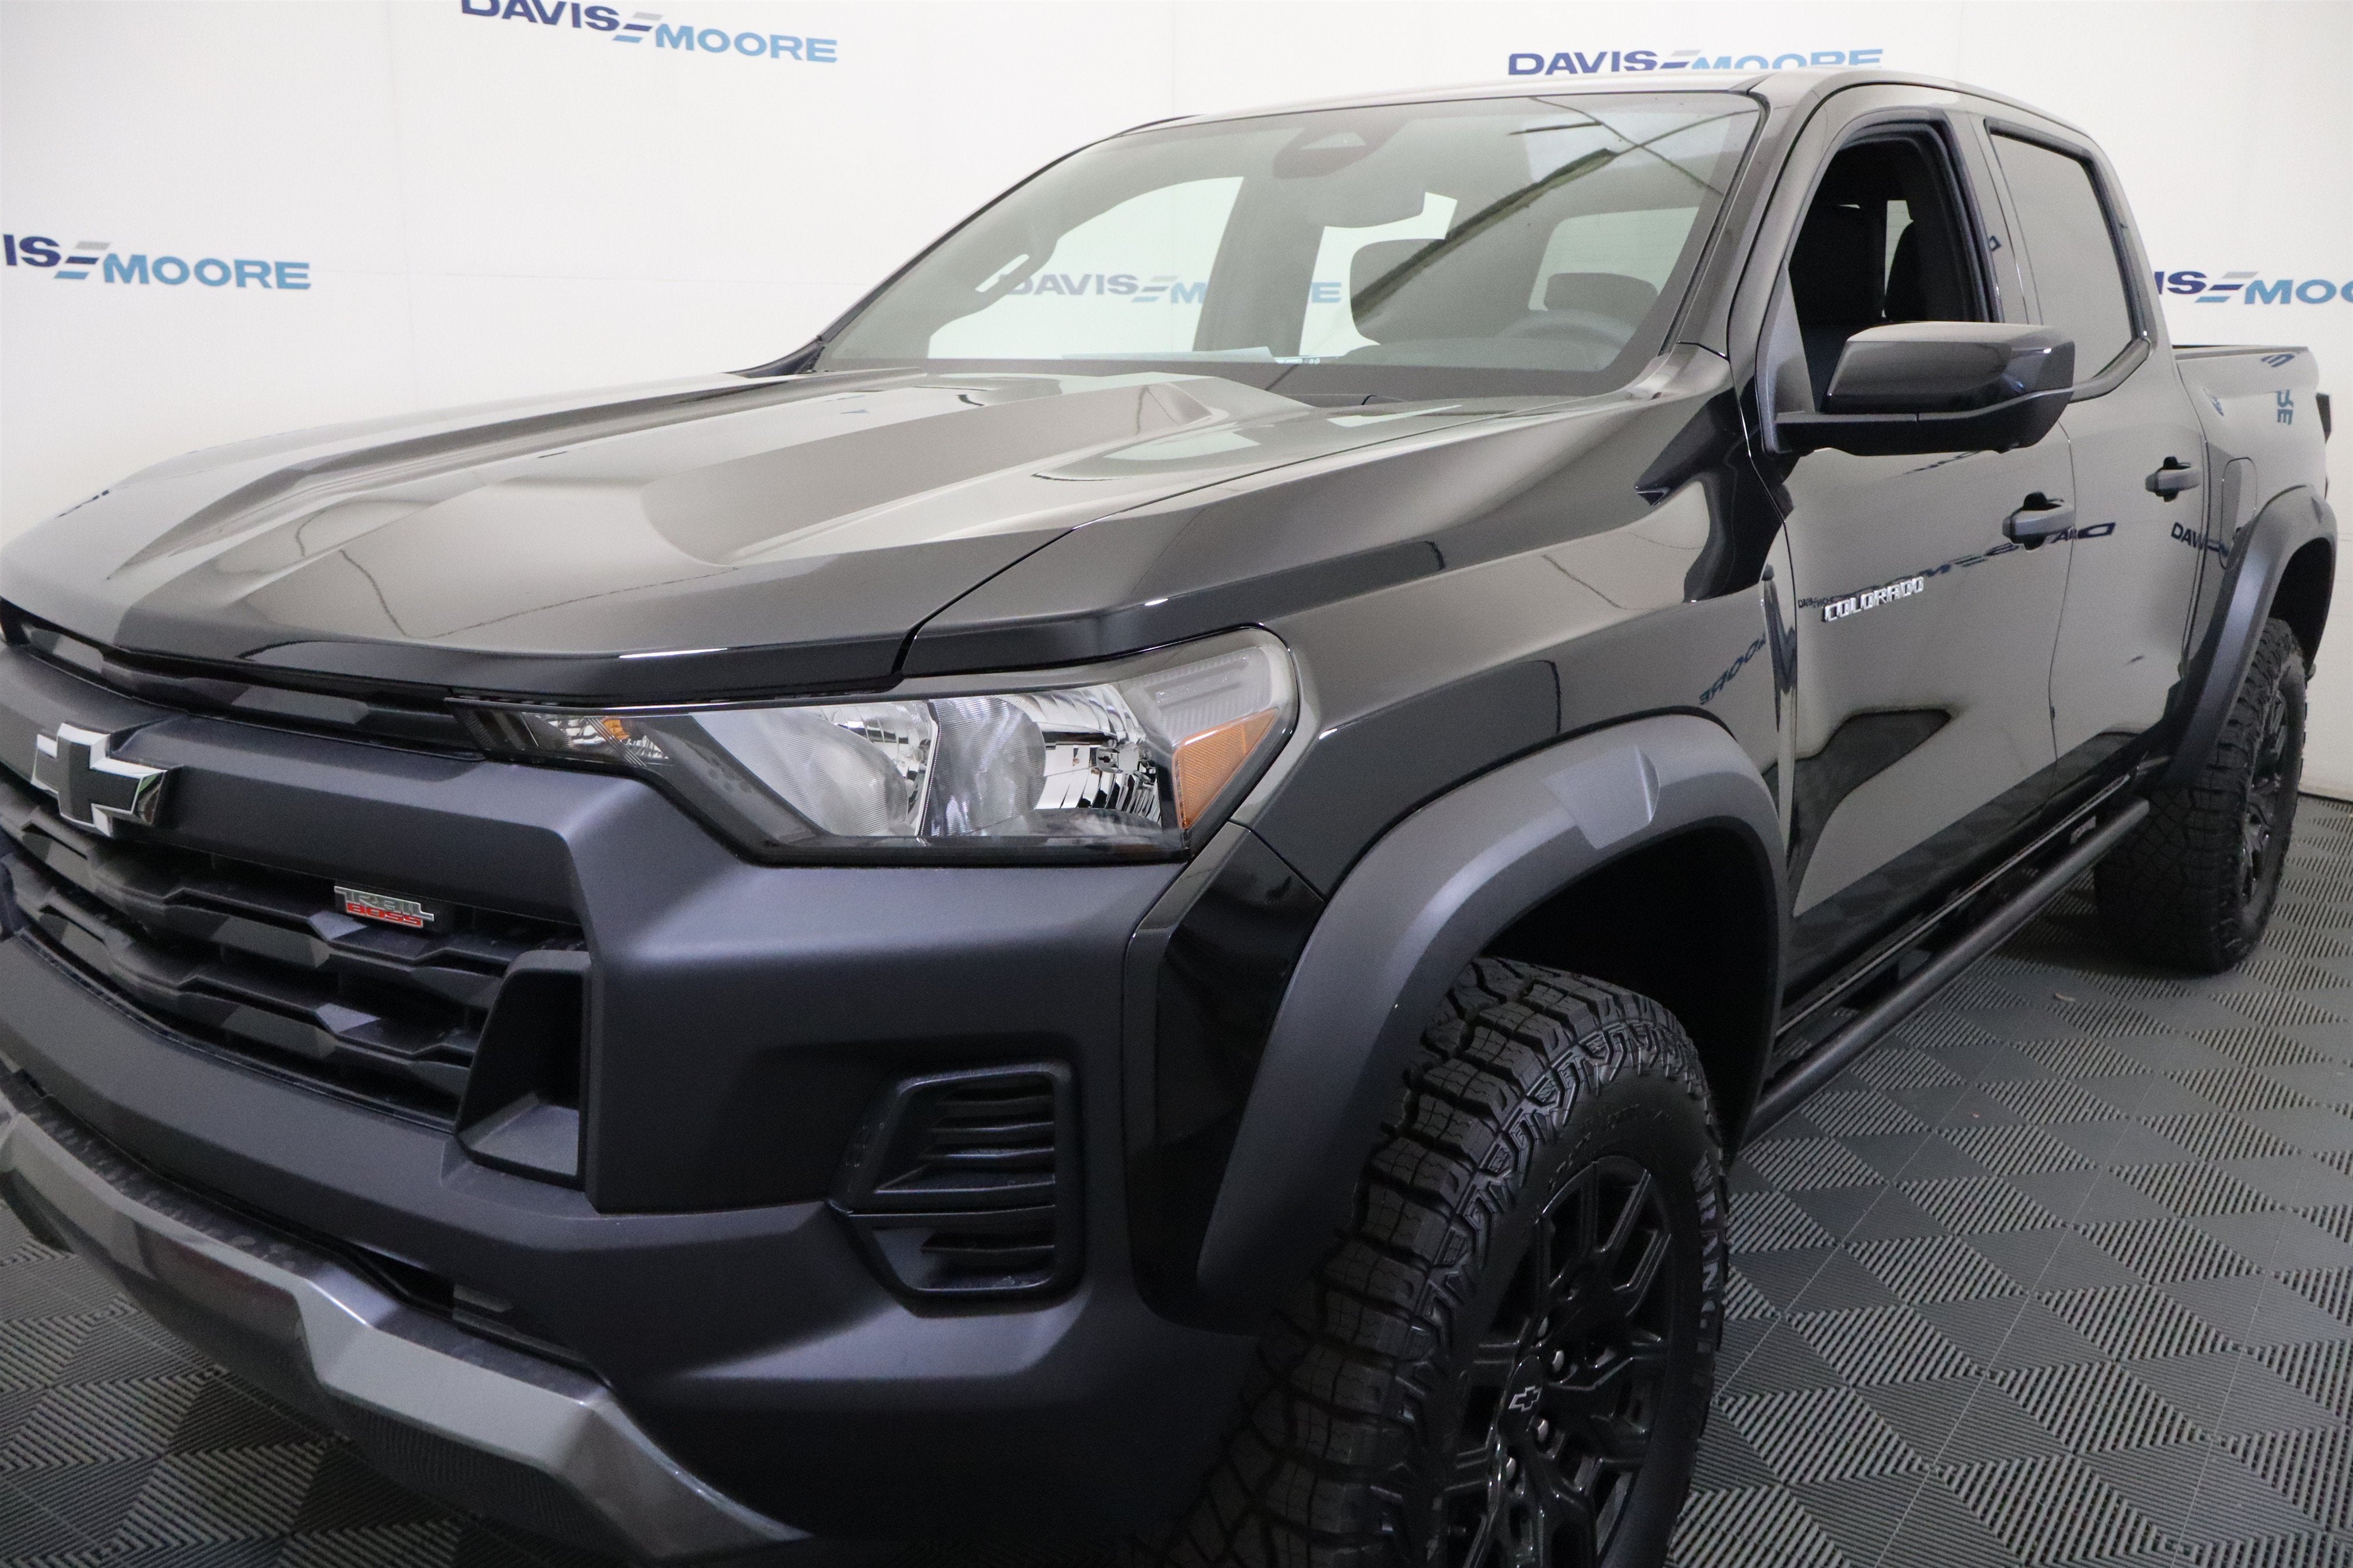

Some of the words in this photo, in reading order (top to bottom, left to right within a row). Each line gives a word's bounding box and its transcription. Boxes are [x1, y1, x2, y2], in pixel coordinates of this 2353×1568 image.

[461, 0, 620, 32] DAVIS
[655, 24, 838, 63] MOORE
[1509, 50, 1658, 75] DAVIS
[103, 253, 311, 289] MOORE
[1823, 576, 1924, 622] COLORADO
[334, 886, 434, 921] TRAIL
[346, 901, 423, 928] BOSS
